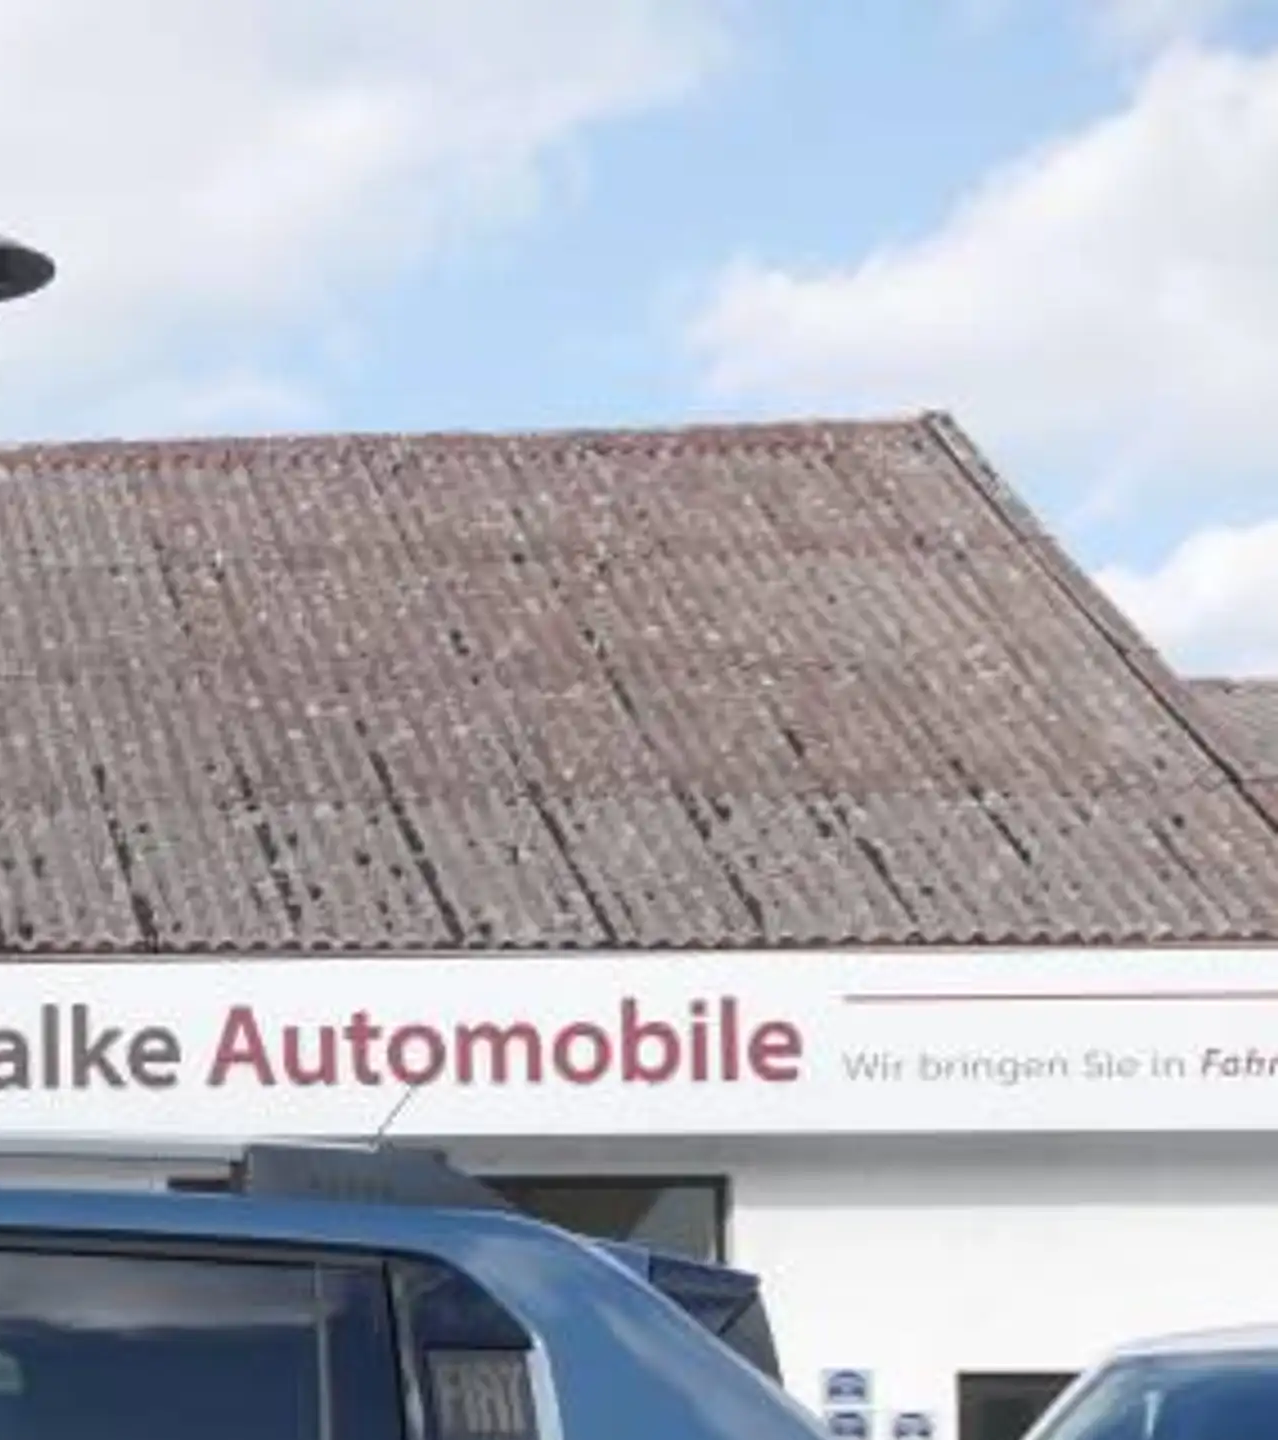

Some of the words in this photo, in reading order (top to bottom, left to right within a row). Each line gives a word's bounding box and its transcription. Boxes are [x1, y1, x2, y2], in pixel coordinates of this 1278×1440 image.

[207, 996, 804, 1087] Automobile
[842, 1051, 903, 1080] Wir
[918, 1051, 1069, 1086] bringen
[1083, 1050, 1141, 1079] Sie
[1151, 1049, 1186, 1078] in
